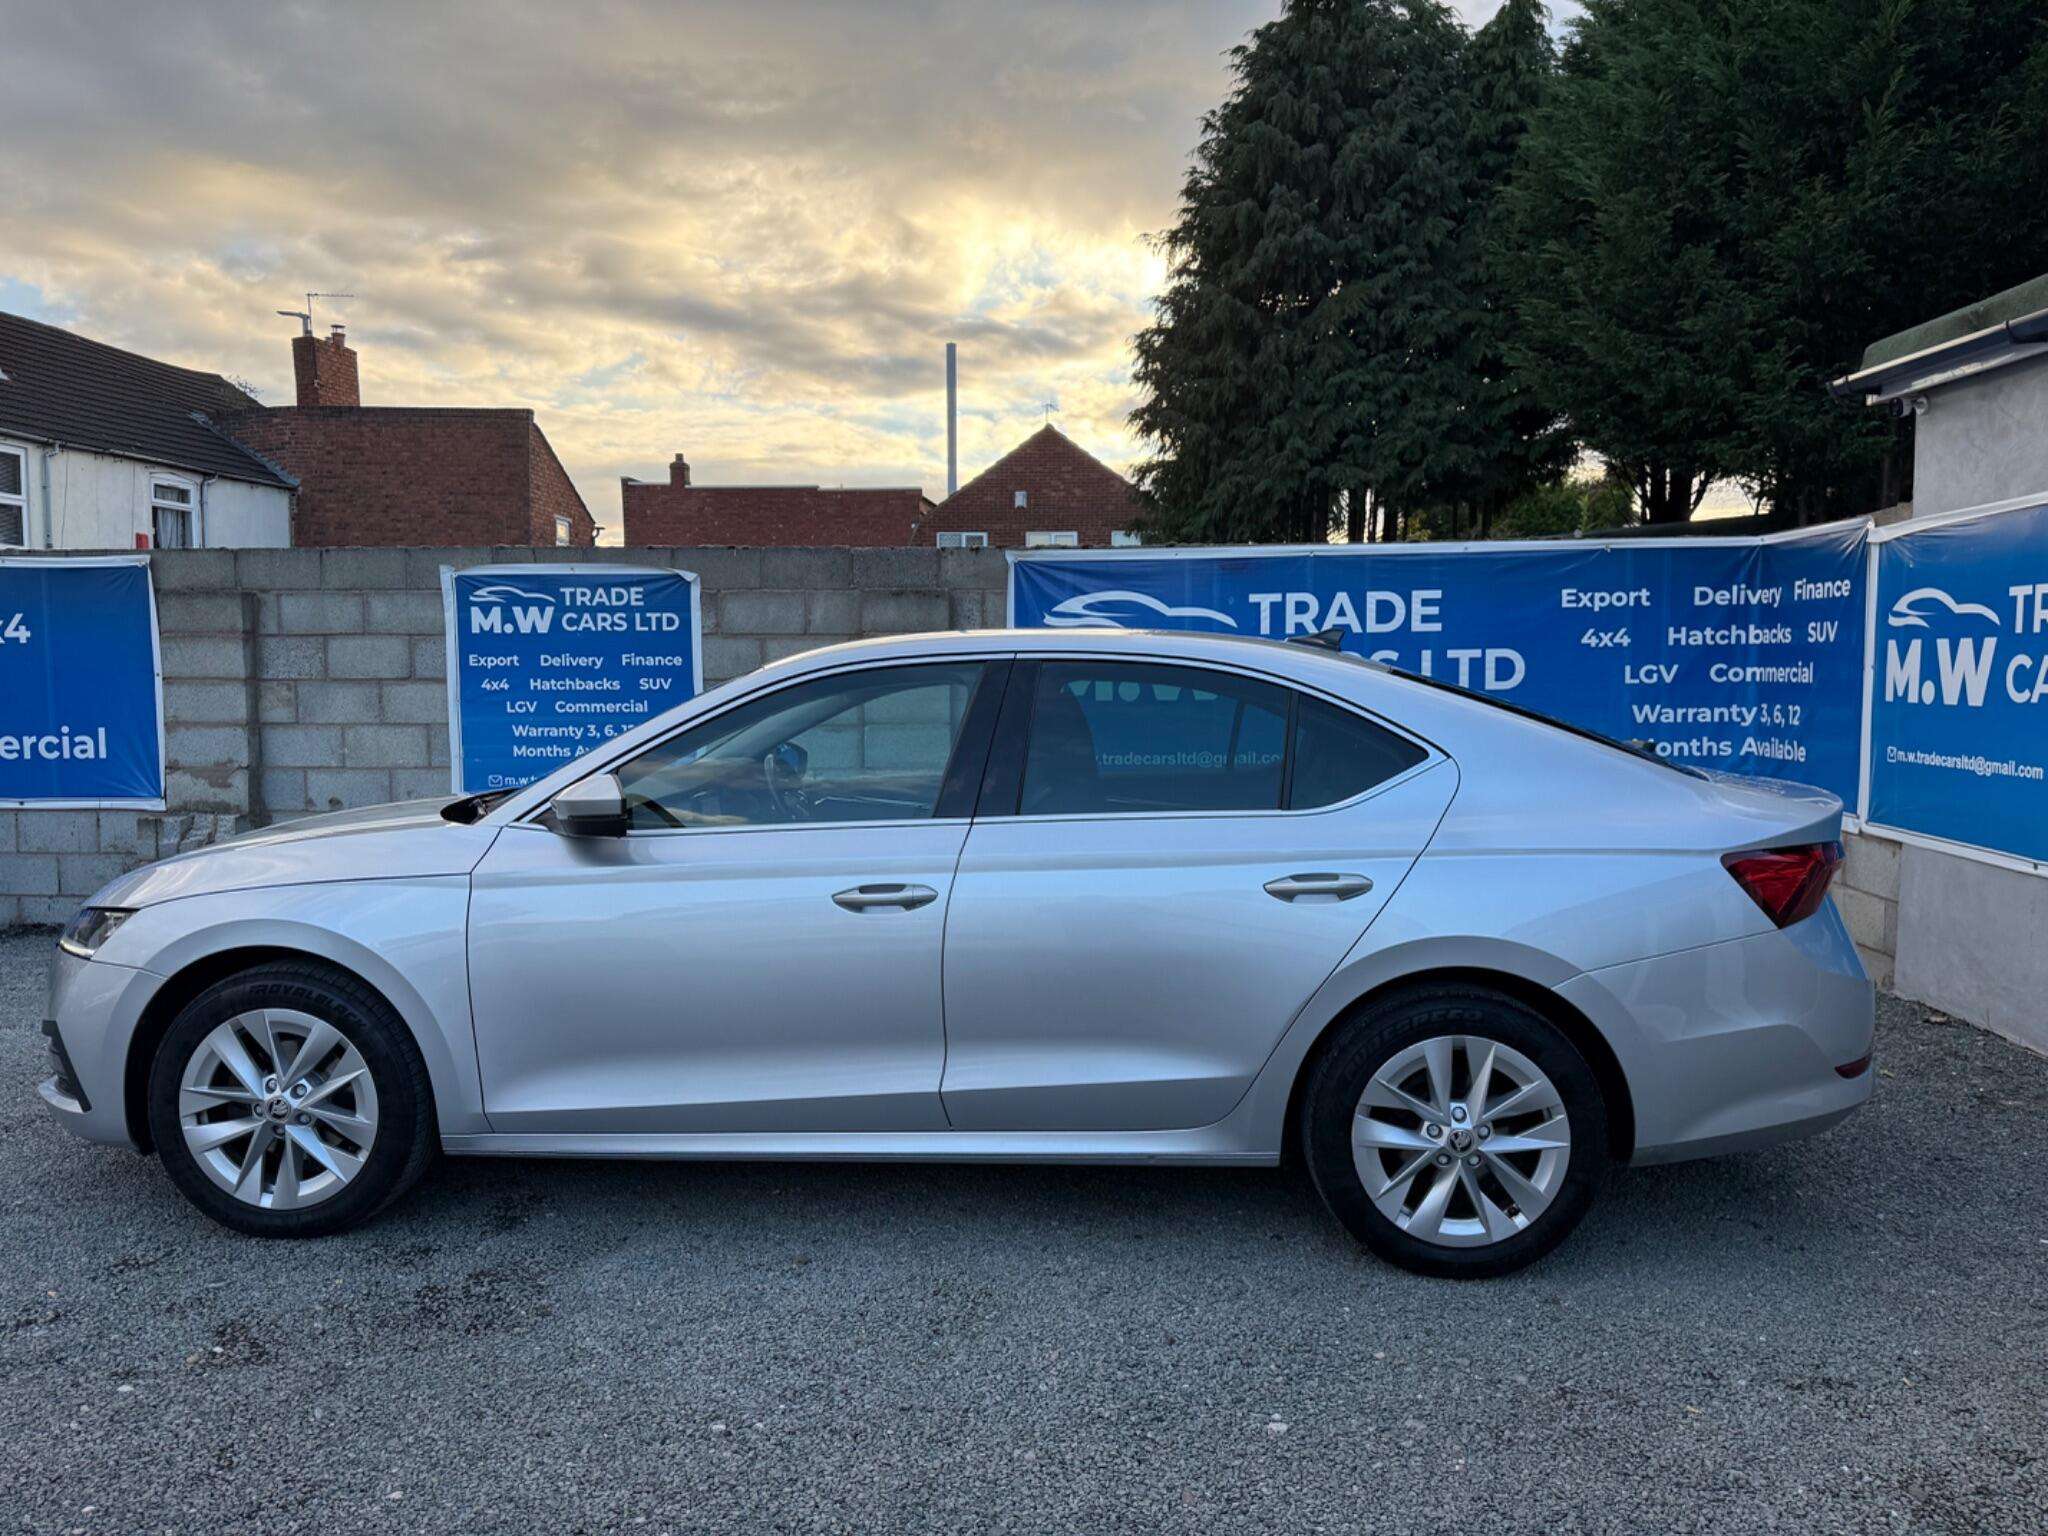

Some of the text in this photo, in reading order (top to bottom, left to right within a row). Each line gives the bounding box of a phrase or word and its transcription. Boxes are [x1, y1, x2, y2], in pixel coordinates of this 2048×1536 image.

[560, 587, 644, 606] TRADE
[1562, 578, 1850, 611] Export Delivery Finance
[470, 606, 554, 634] M.W
[562, 613, 680, 631] CARS LTD
[1249, 589, 1442, 634] TRADE
[1582, 621, 1838, 647] 4x4 Hatchbacks SUV
[469, 653, 683, 669] Export Delivery Finance
[1885, 637, 1998, 707] M.W
[481, 678, 672, 690] 4x4 Hatchbacks SUV
[1624, 662, 1814, 684] LGV Commercial
[507, 700, 648, 713] LGV Commercial
[1632, 703, 1801, 728] Warranty 3, 6, 12
[512, 724, 584, 739] Warranty
[587, 724, 600, 739] 3,
[513, 745, 571, 757] Months
[1632, 736, 1806, 762] onths Available
[1896, 750, 2044, 780] m.w.tradecarsltd@gmail.com
